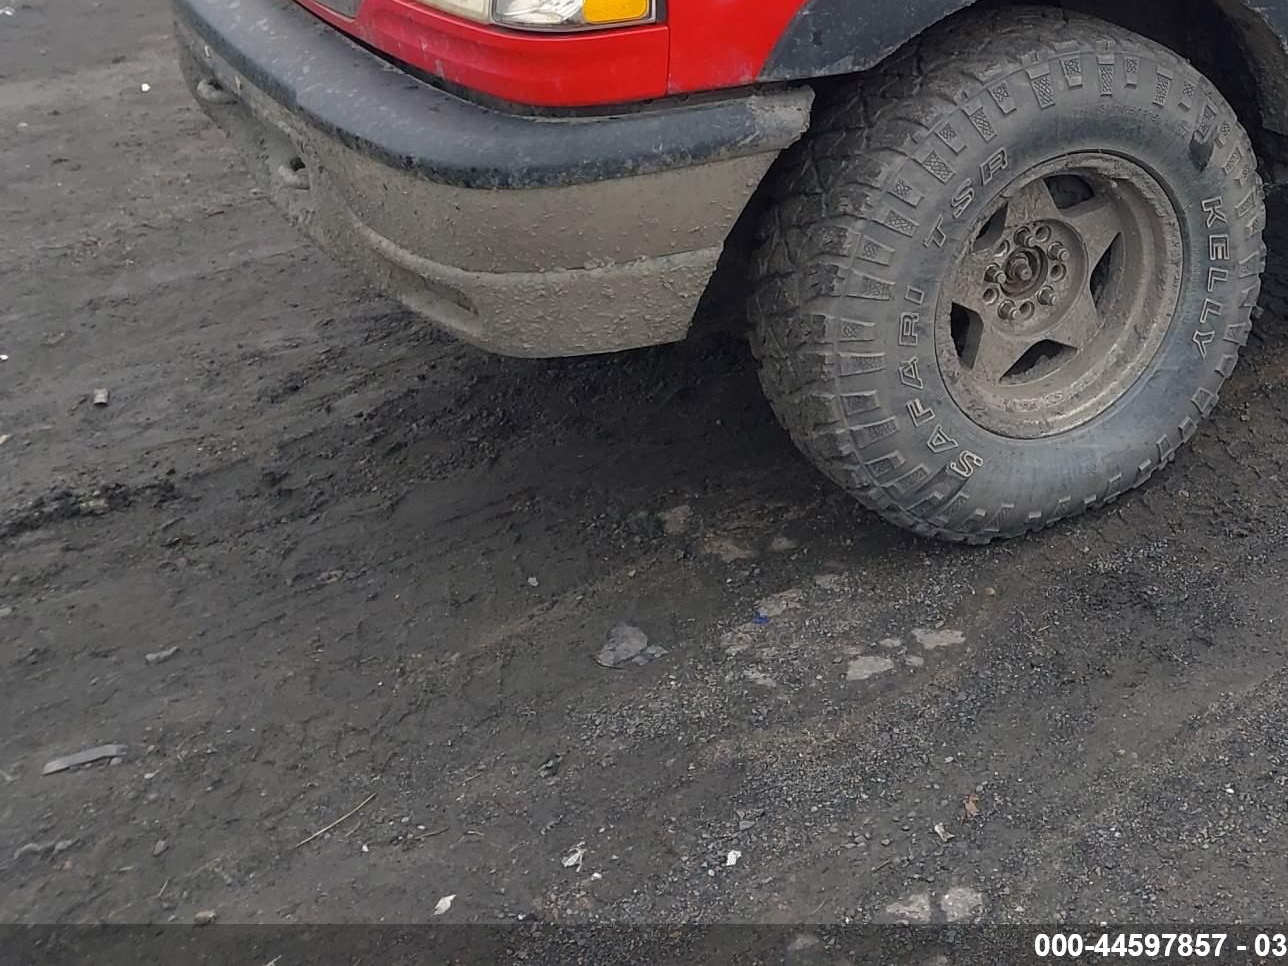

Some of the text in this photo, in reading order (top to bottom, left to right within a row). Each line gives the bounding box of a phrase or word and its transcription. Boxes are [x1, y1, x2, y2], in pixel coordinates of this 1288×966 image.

[898, 146, 1009, 479] SAFARI TSR
[1192, 195, 1231, 359] KELLY
